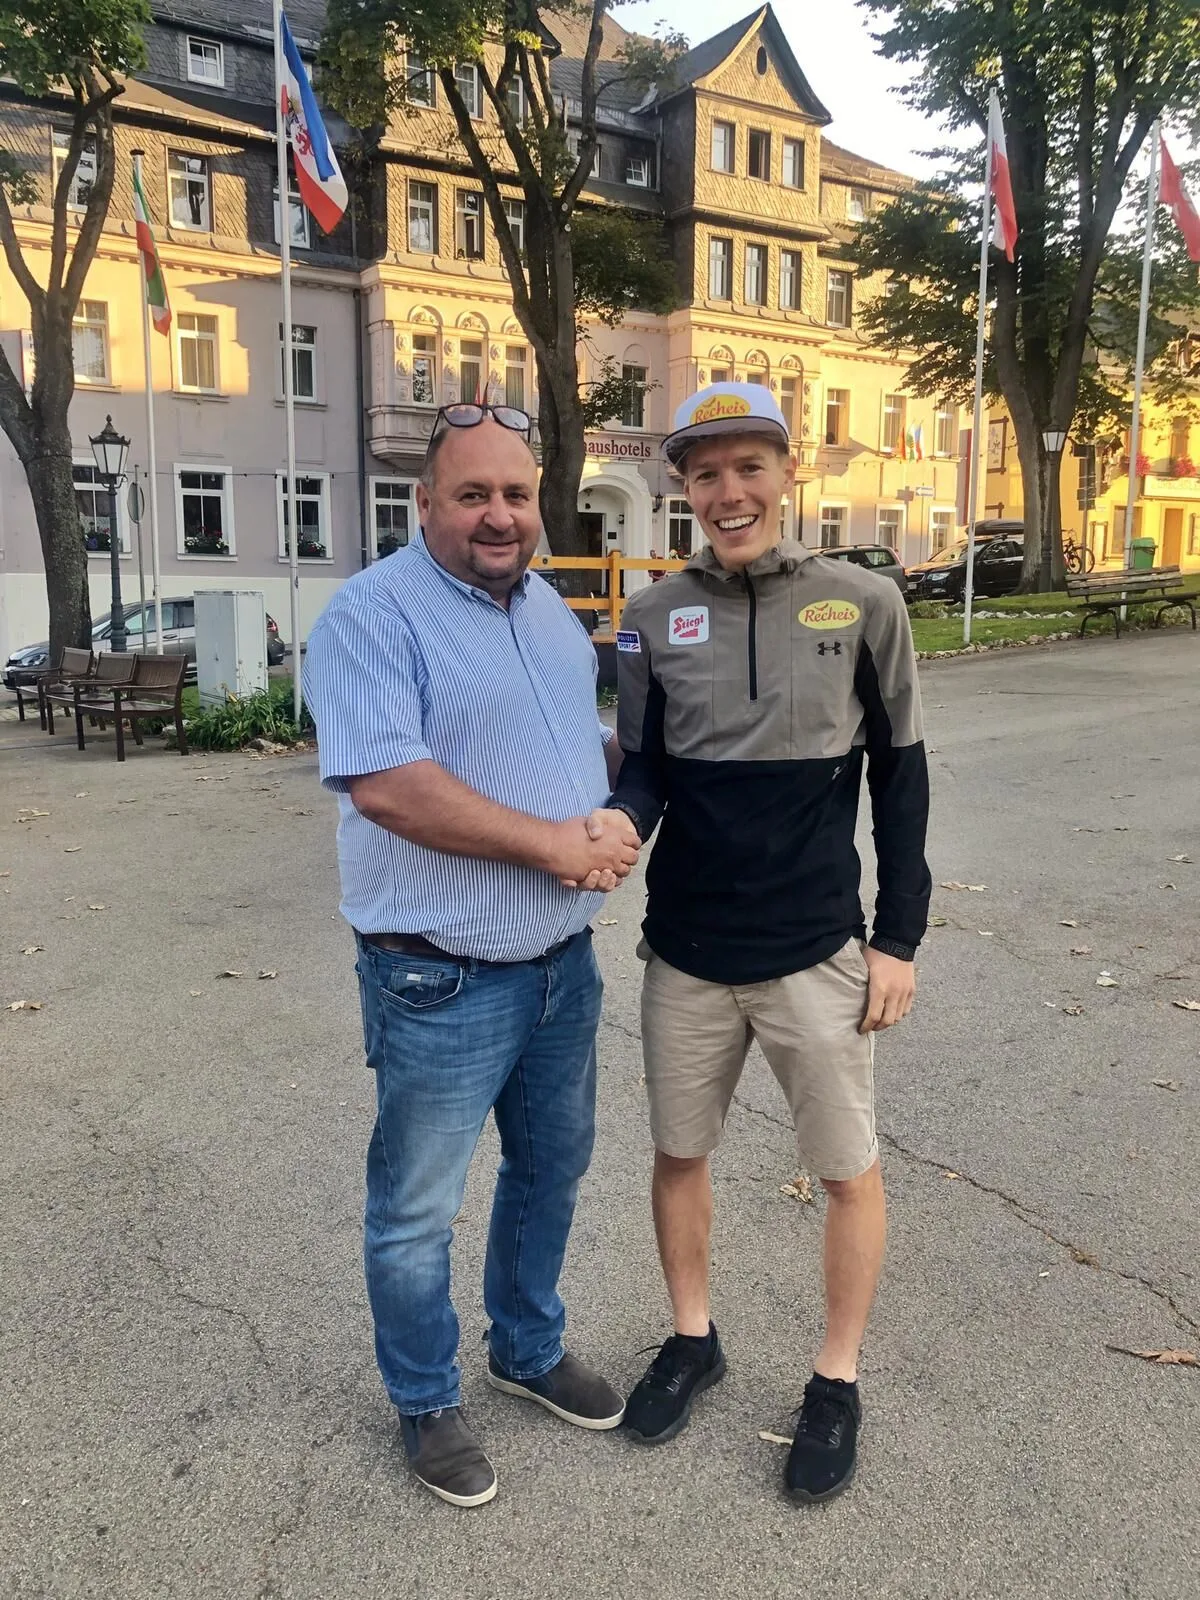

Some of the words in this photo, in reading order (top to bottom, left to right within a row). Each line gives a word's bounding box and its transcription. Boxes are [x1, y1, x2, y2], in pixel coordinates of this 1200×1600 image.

[695, 400, 745, 424] Recheis
[673, 614, 704, 635] Stiegl
[804, 606, 855, 623] Recheis
